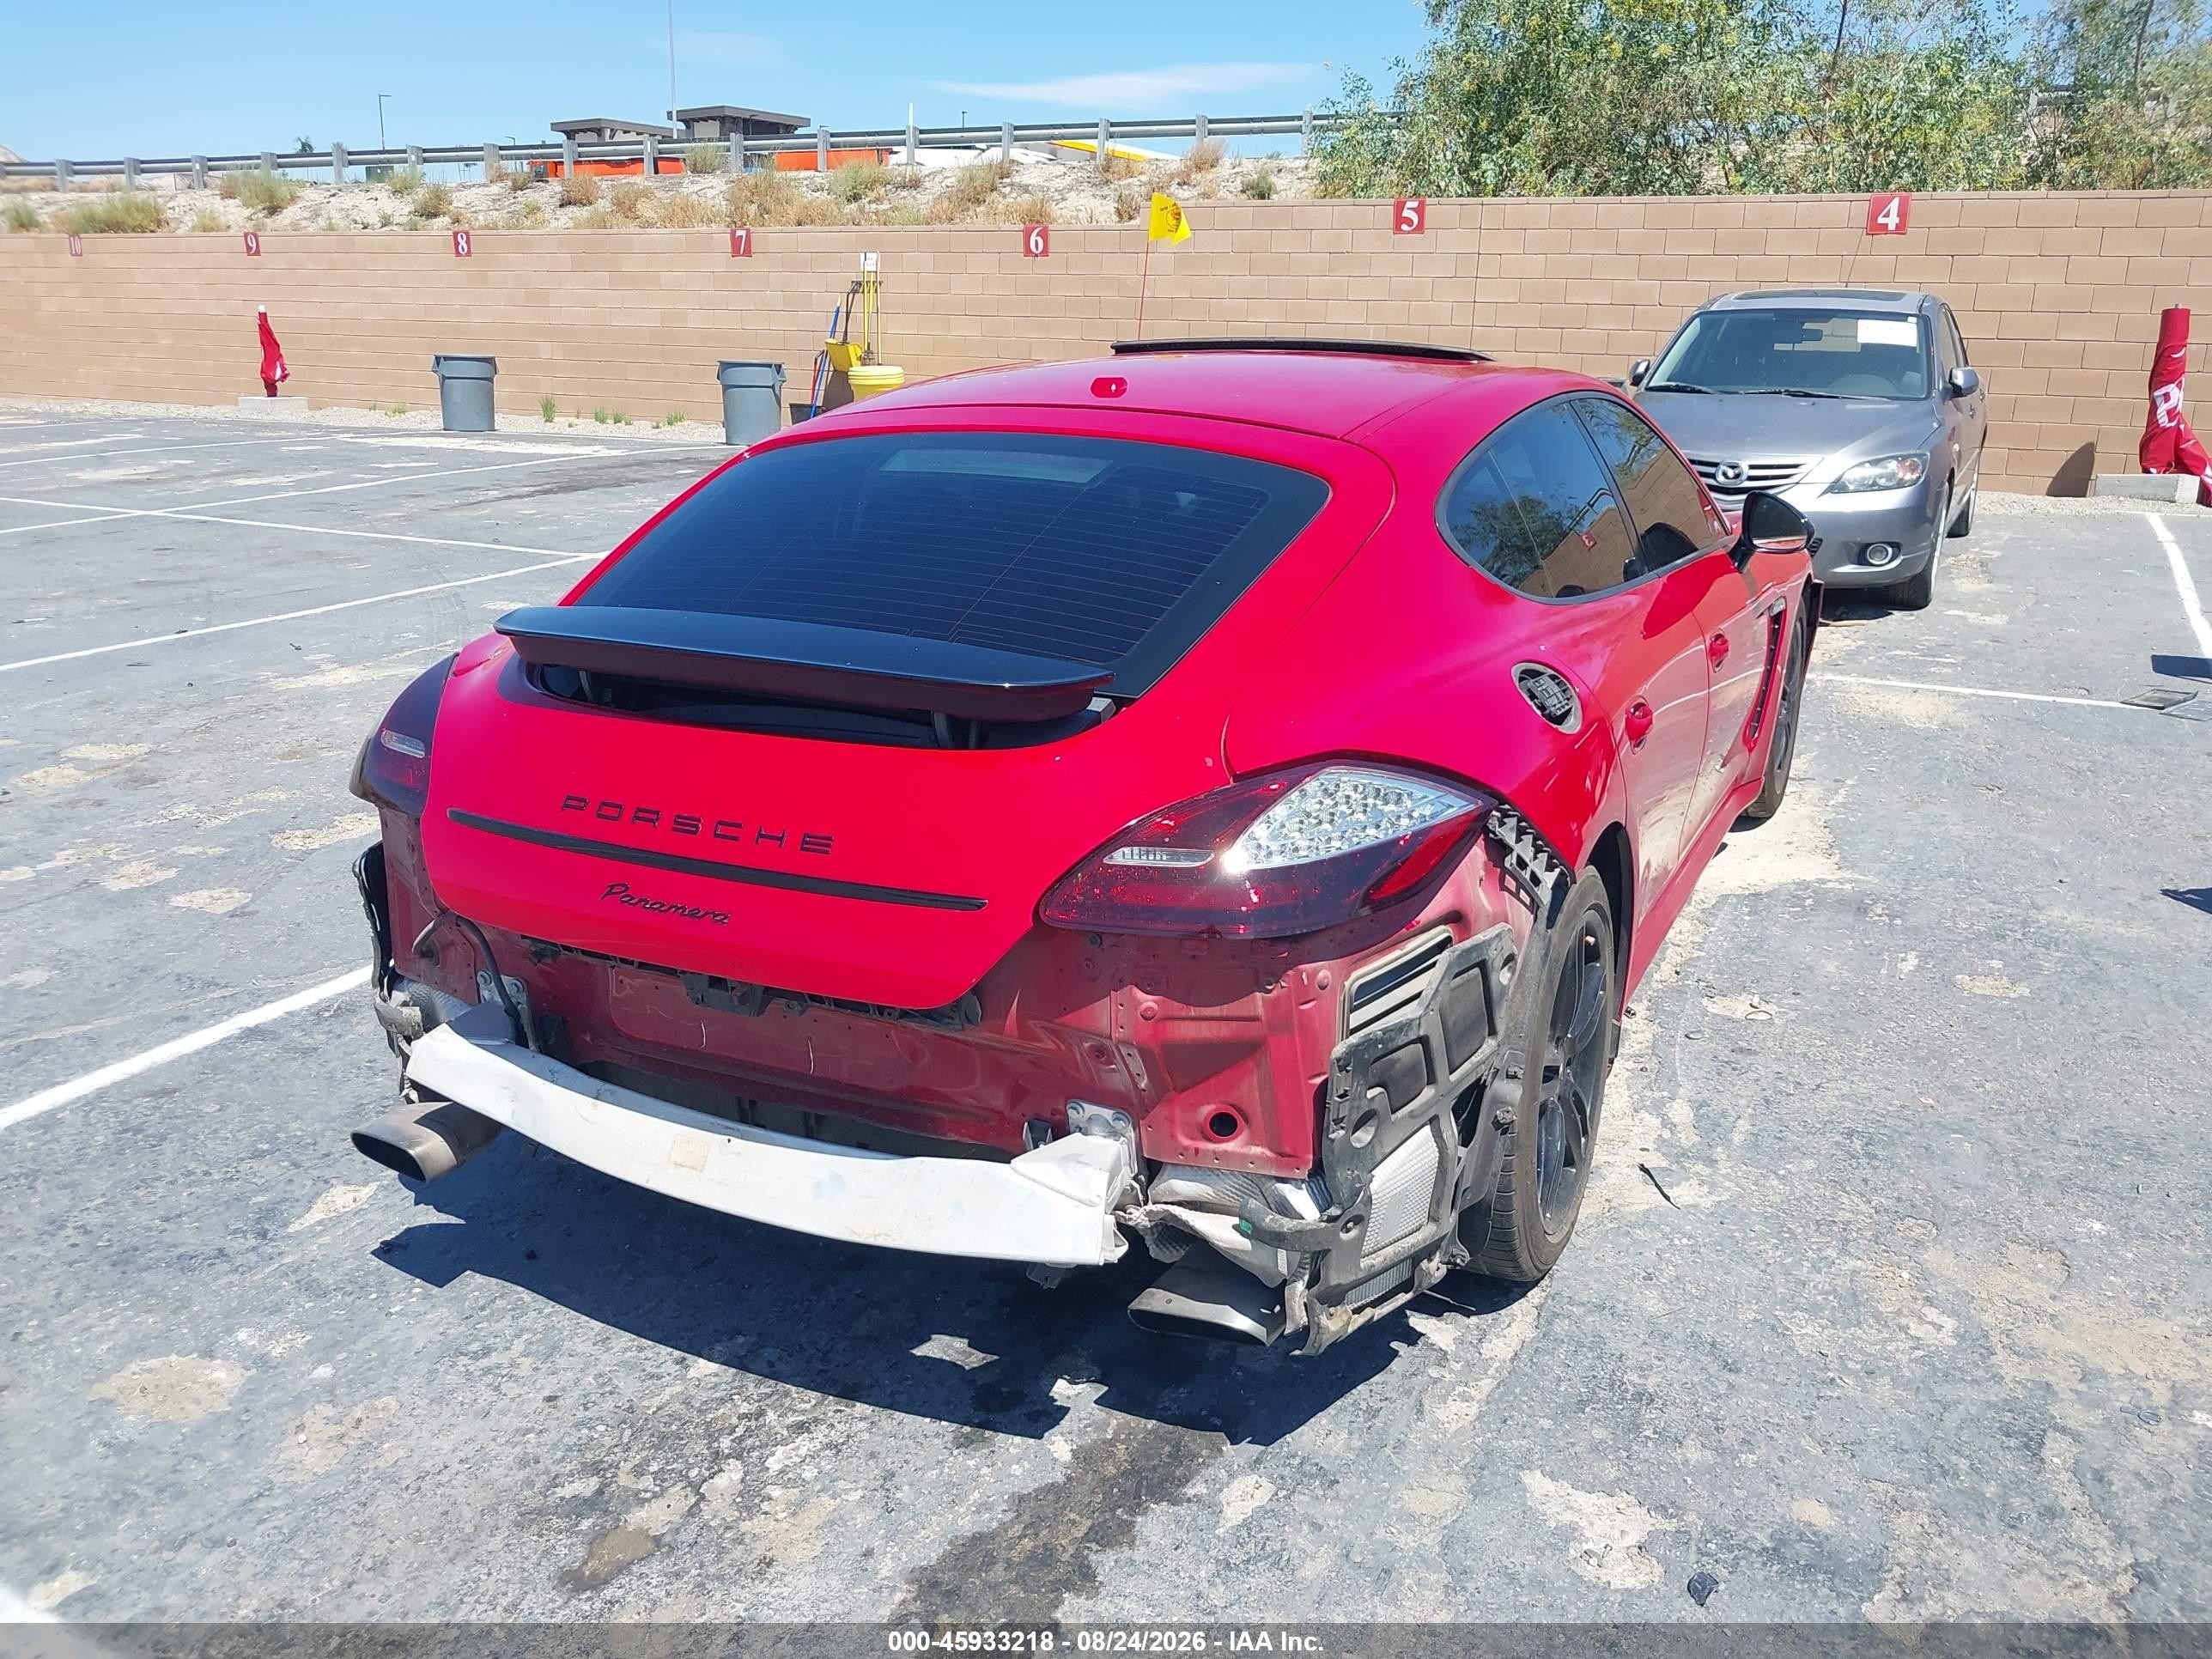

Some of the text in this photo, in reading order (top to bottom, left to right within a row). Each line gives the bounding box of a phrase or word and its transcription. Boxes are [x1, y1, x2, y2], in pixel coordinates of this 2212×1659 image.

[1401, 200, 1419, 231] 5
[1877, 197, 1900, 231] 4
[70, 237, 82, 255] 10
[247, 234, 257, 254] 9
[457, 233, 468, 254] 8
[735, 229, 747, 255] 7
[1030, 227, 1044, 254] 6
[562, 794, 835, 854] PORSCHE
[601, 882, 731, 925] Panamera
